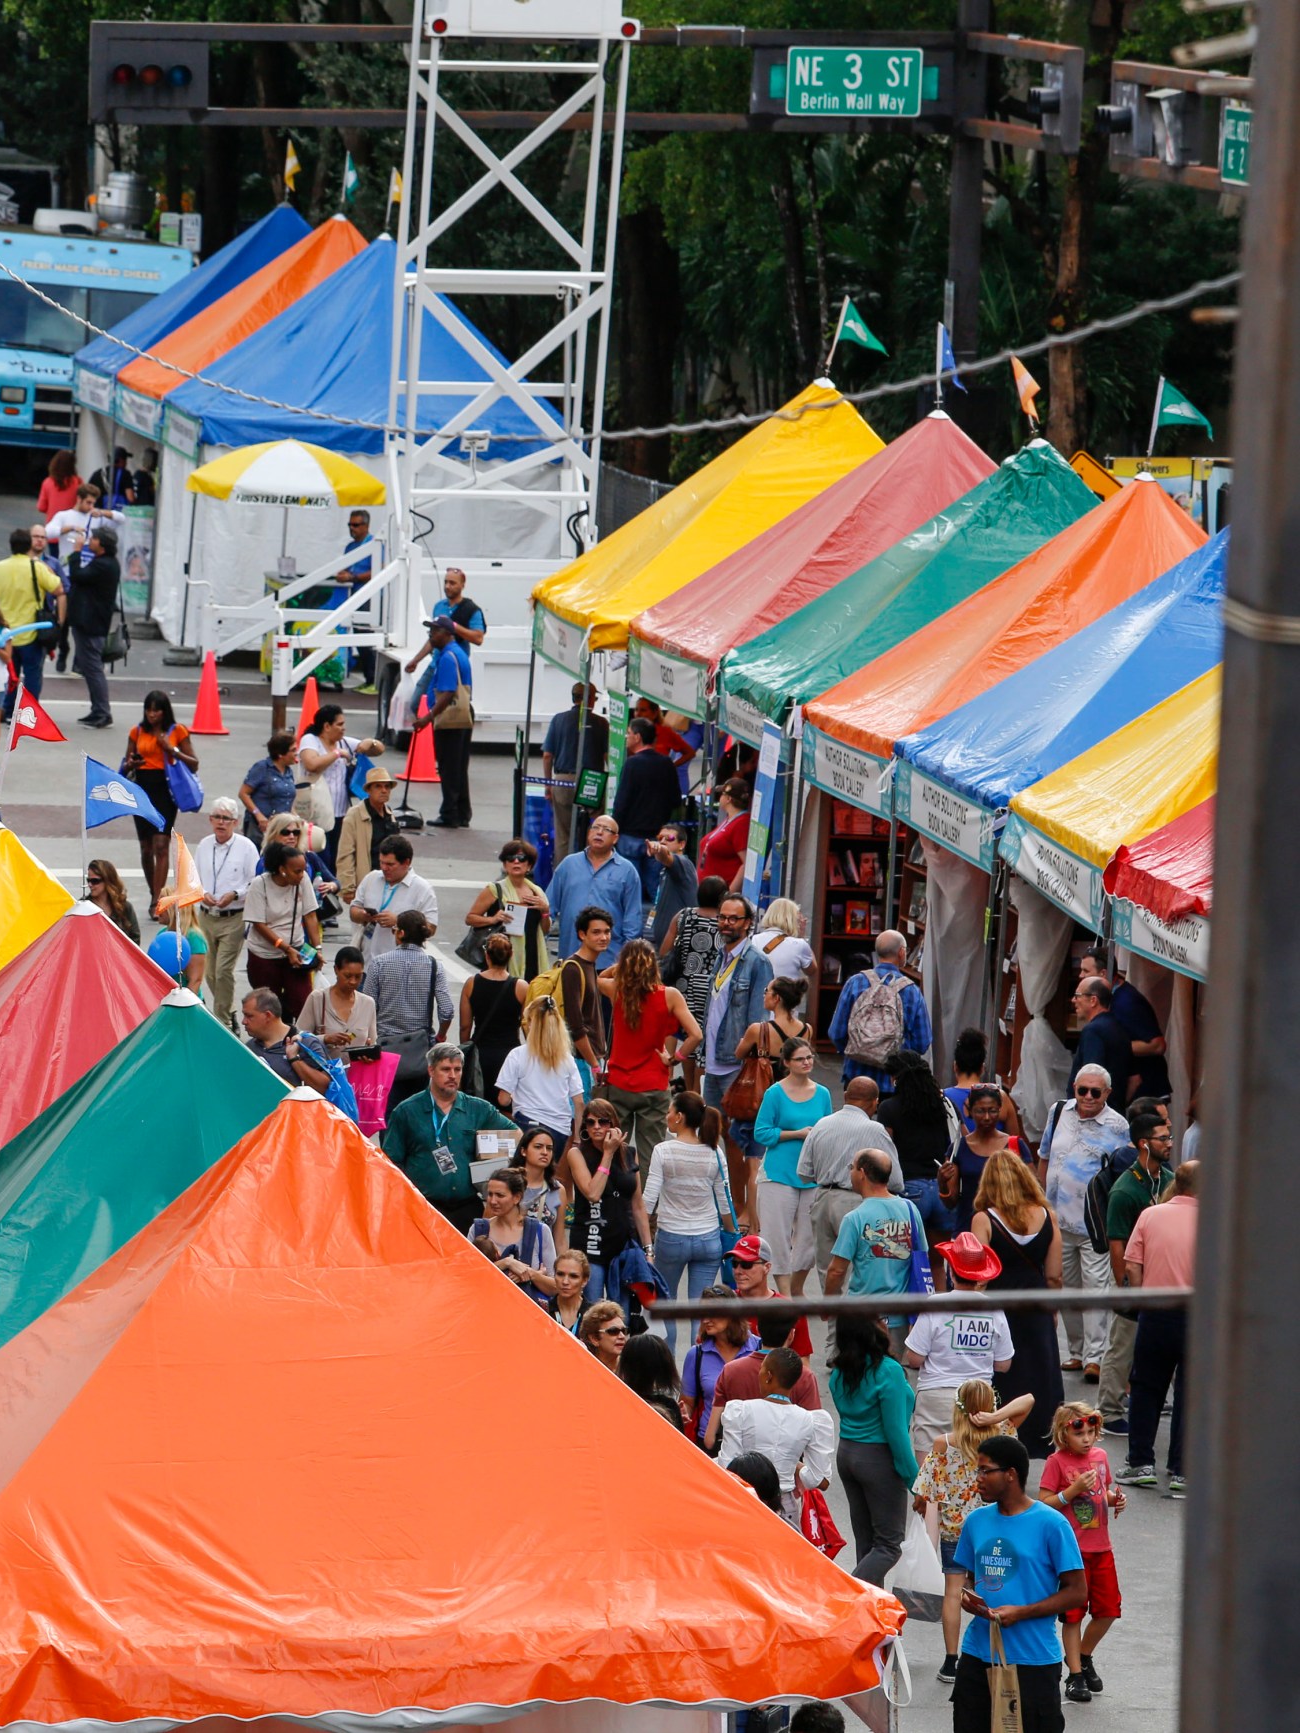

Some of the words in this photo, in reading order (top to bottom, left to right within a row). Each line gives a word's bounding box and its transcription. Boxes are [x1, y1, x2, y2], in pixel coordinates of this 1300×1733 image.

[796, 56, 824, 86] NE
[843, 53, 863, 89] 3
[887, 57, 913, 87] ST
[801, 92, 839, 109] Berlin
[846, 93, 872, 110] Wall
[879, 93, 905, 114] Way
[843, 752, 870, 779] SOLUTIONS
[922, 783, 941, 814] AUTHOR
[941, 793, 969, 826] SOLUTIONS
[928, 812, 942, 835] BOOK
[942, 818, 962, 847] GALLERY
[959, 1319, 963, 1331] I
[966, 1320, 990, 1333] AM
[956, 1334, 990, 1347] MDC
[992, 1546, 1002, 1556] BE
[980, 1556, 1012, 1567] AWESOME
[984, 1566, 1006, 1577] TODAY.
